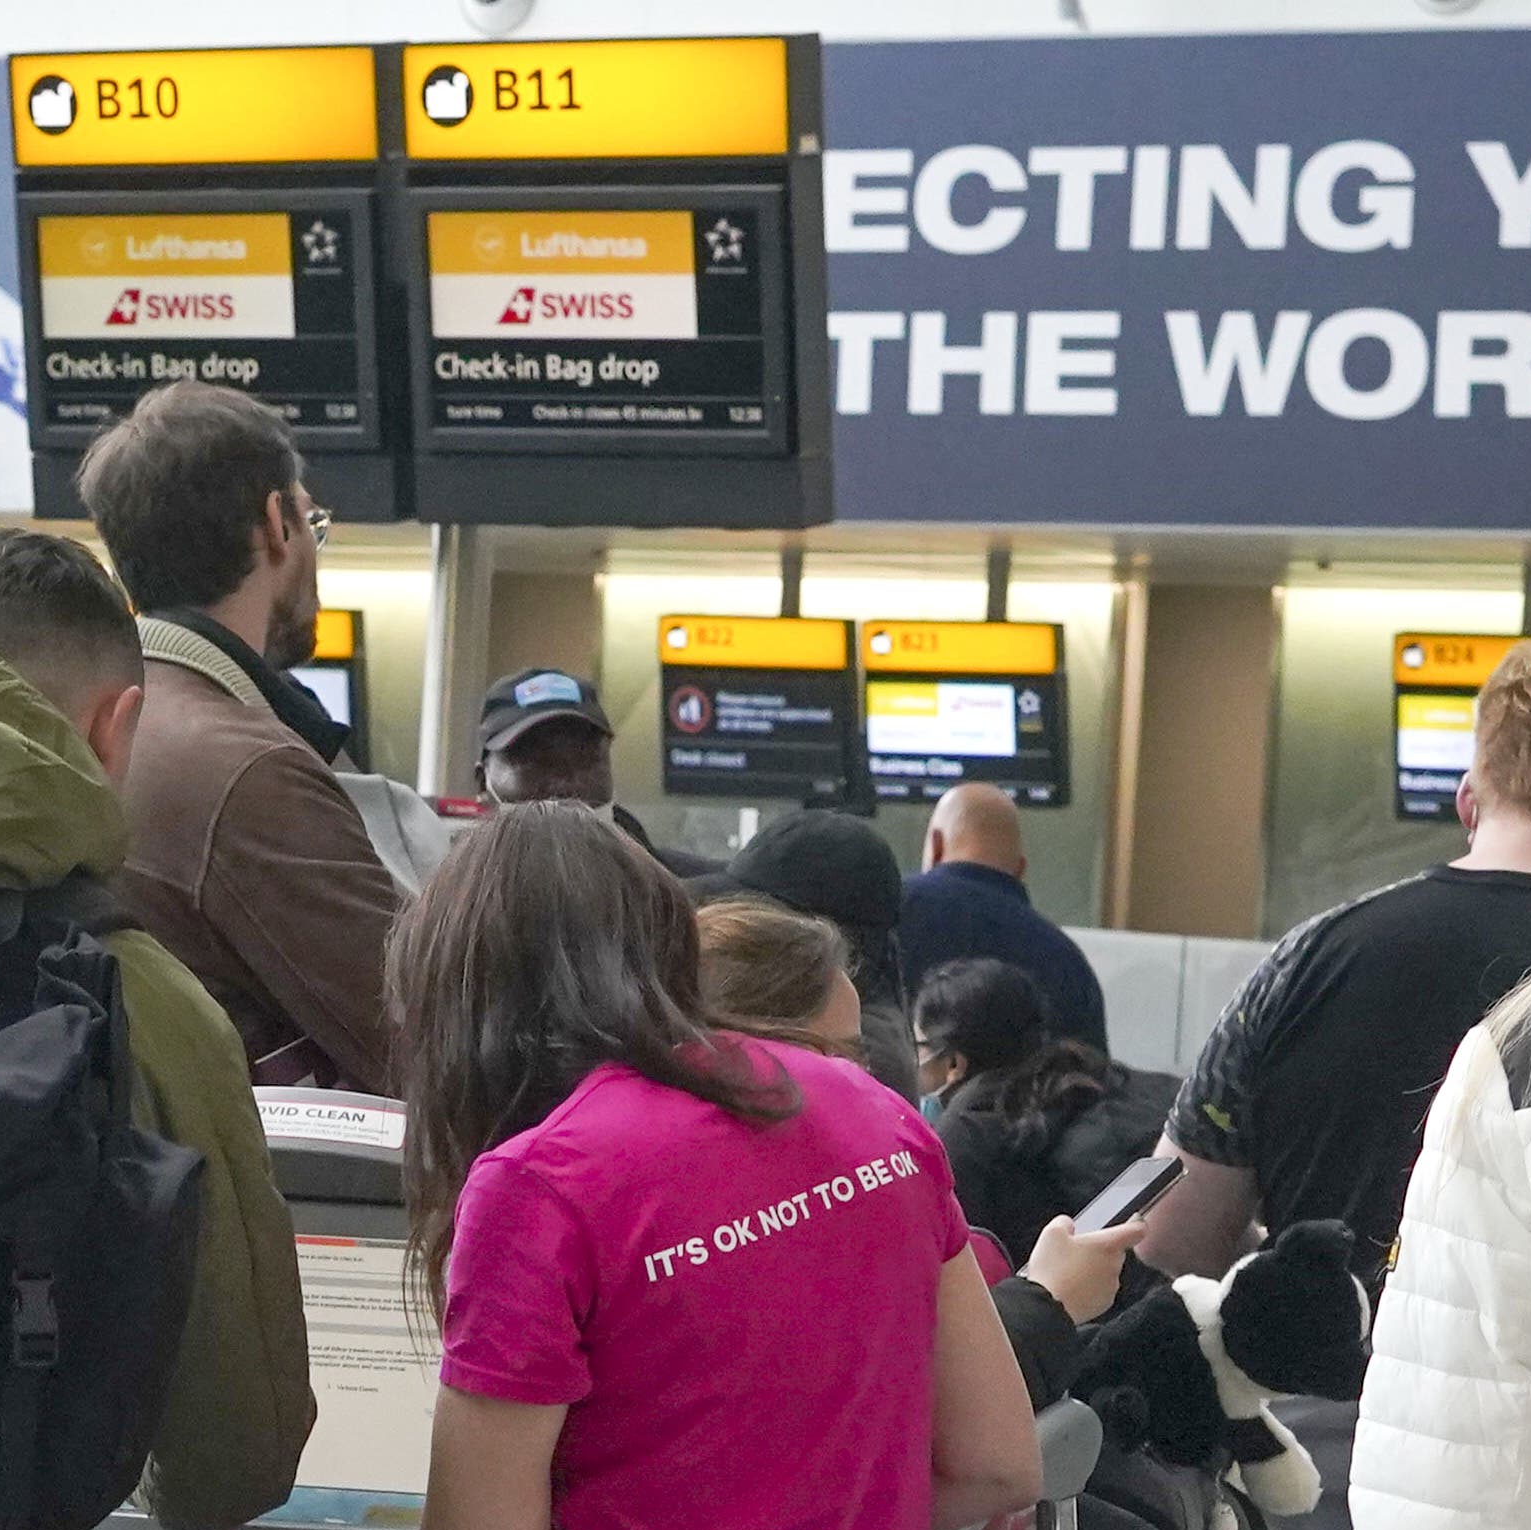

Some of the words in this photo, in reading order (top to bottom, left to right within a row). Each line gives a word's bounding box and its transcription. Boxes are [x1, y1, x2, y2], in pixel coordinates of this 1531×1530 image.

[96, 76, 180, 120] B10
[494, 68, 581, 112] B11
[823, 139, 1416, 254] ECTING
[126, 235, 248, 261] Lufthansa
[520, 231, 648, 259] Lufthansa
[146, 294, 235, 320] SWISS
[542, 293, 634, 319] SWISS
[46, 352, 147, 381] Check-in
[151, 353, 197, 381] Bag
[201, 352, 260, 385] drop
[435, 352, 540, 381] Check-in
[545, 353, 593, 388] Bag
[599, 353, 660, 388] drop
[827, 310, 1121, 416] THE
[305, 1108, 366, 1123] CLEAN
[643, 1236, 709, 1283] IT'S
[713, 1215, 758, 1253] OK
[757, 1191, 810, 1237] NOT
[813, 1175, 855, 1210] TO
[855, 1158, 894, 1193] BE
